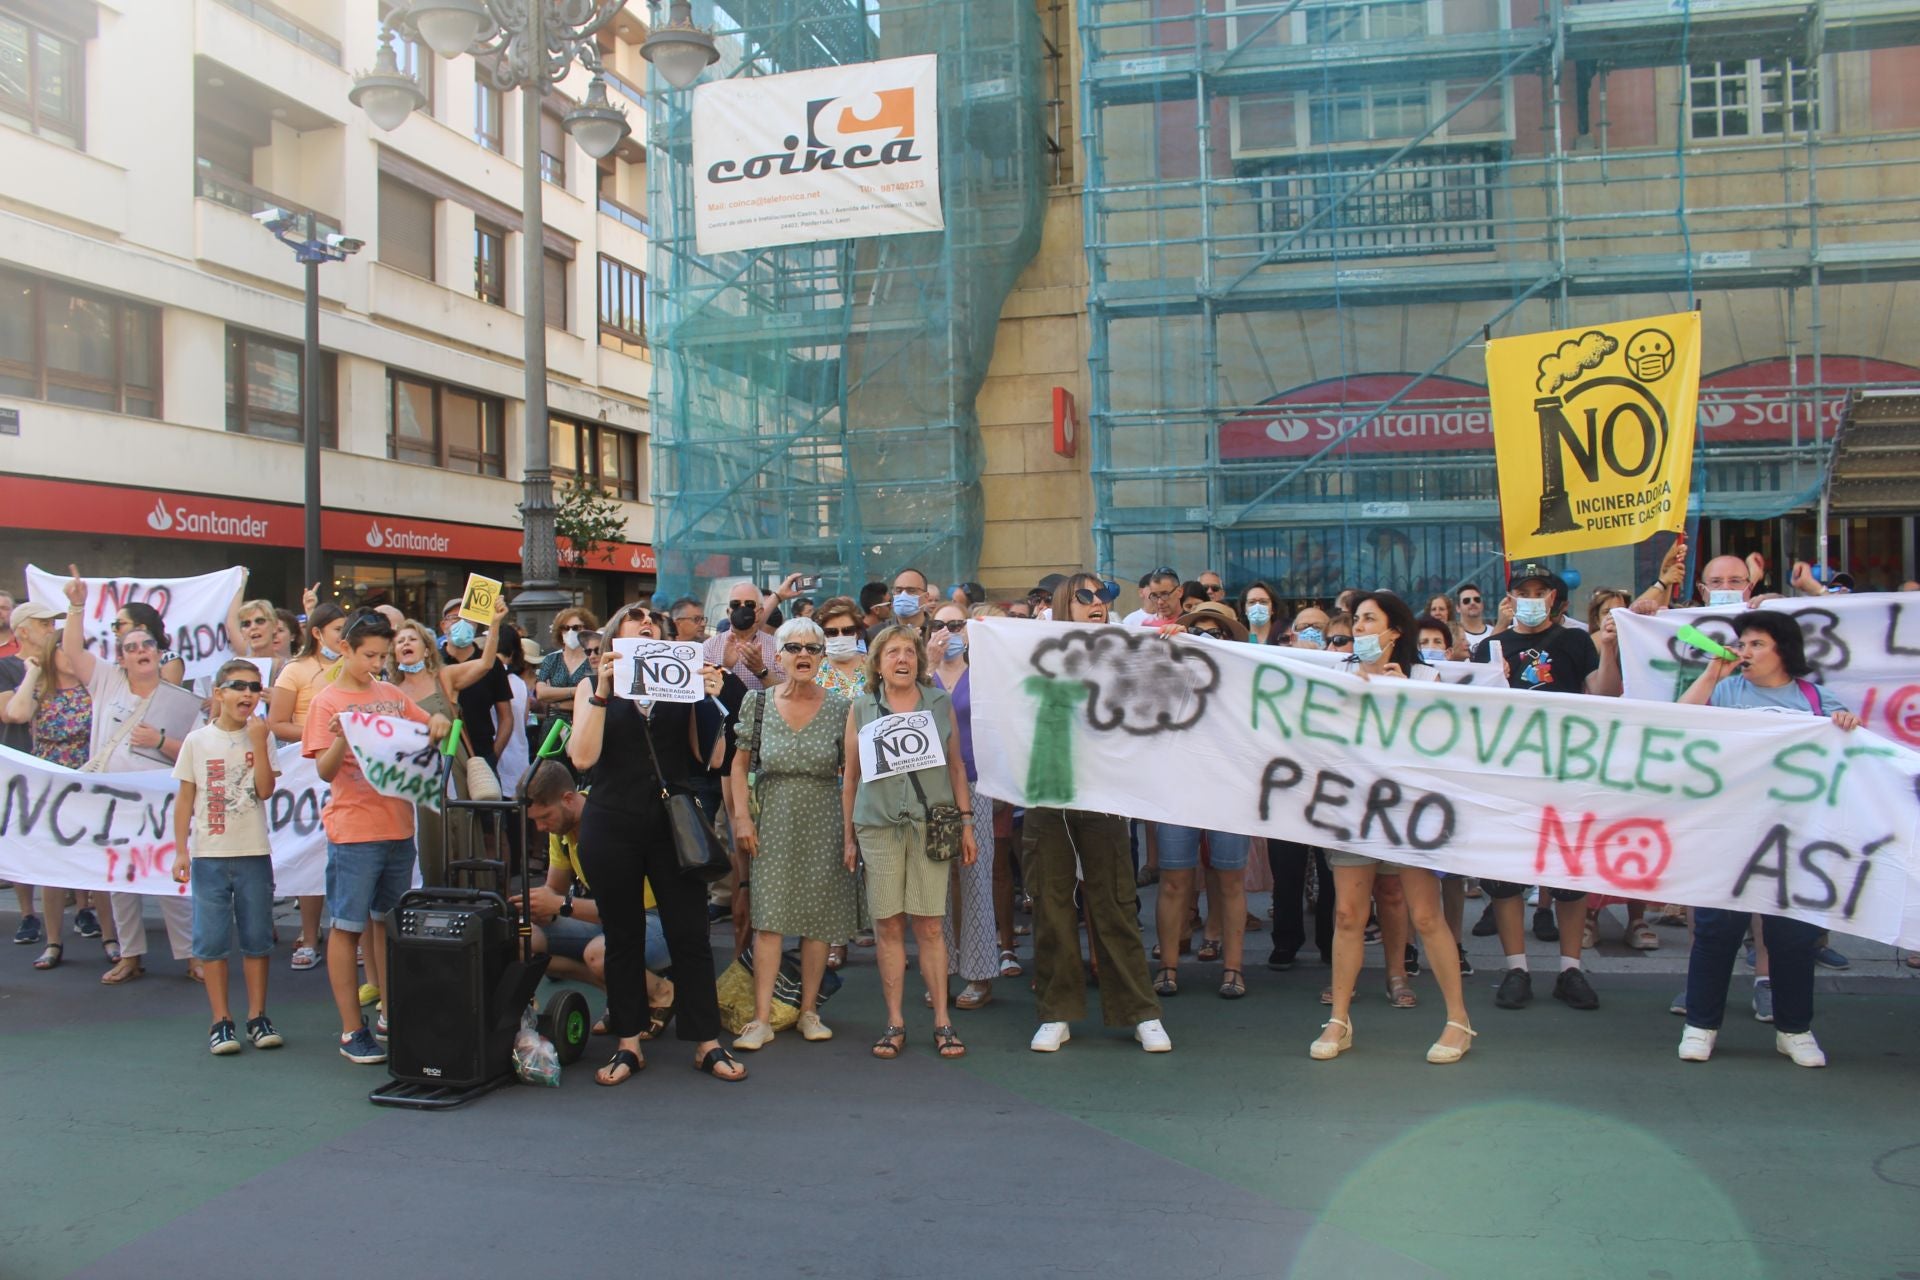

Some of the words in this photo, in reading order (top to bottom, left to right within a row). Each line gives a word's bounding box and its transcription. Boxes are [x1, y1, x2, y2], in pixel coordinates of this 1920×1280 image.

[708, 135, 922, 184] coinca
[729, 191, 821, 208] coinca@telefonica.net
[1535, 396, 1657, 515] NO
[1576, 480, 1671, 514] INCINERADORA
[175, 507, 268, 538] Santander
[1587, 512, 1635, 531] PUENTE
[1639, 499, 1671, 523] CASTRO
[385, 527, 450, 552] Santander
[465, 588, 490, 608] NO
[631, 655, 685, 690] NO
[1251, 662, 1723, 799] RENOVABLES
[874, 734, 923, 768] NO
[1259, 757, 1456, 850] PERO
[1533, 804, 1673, 891] NO
